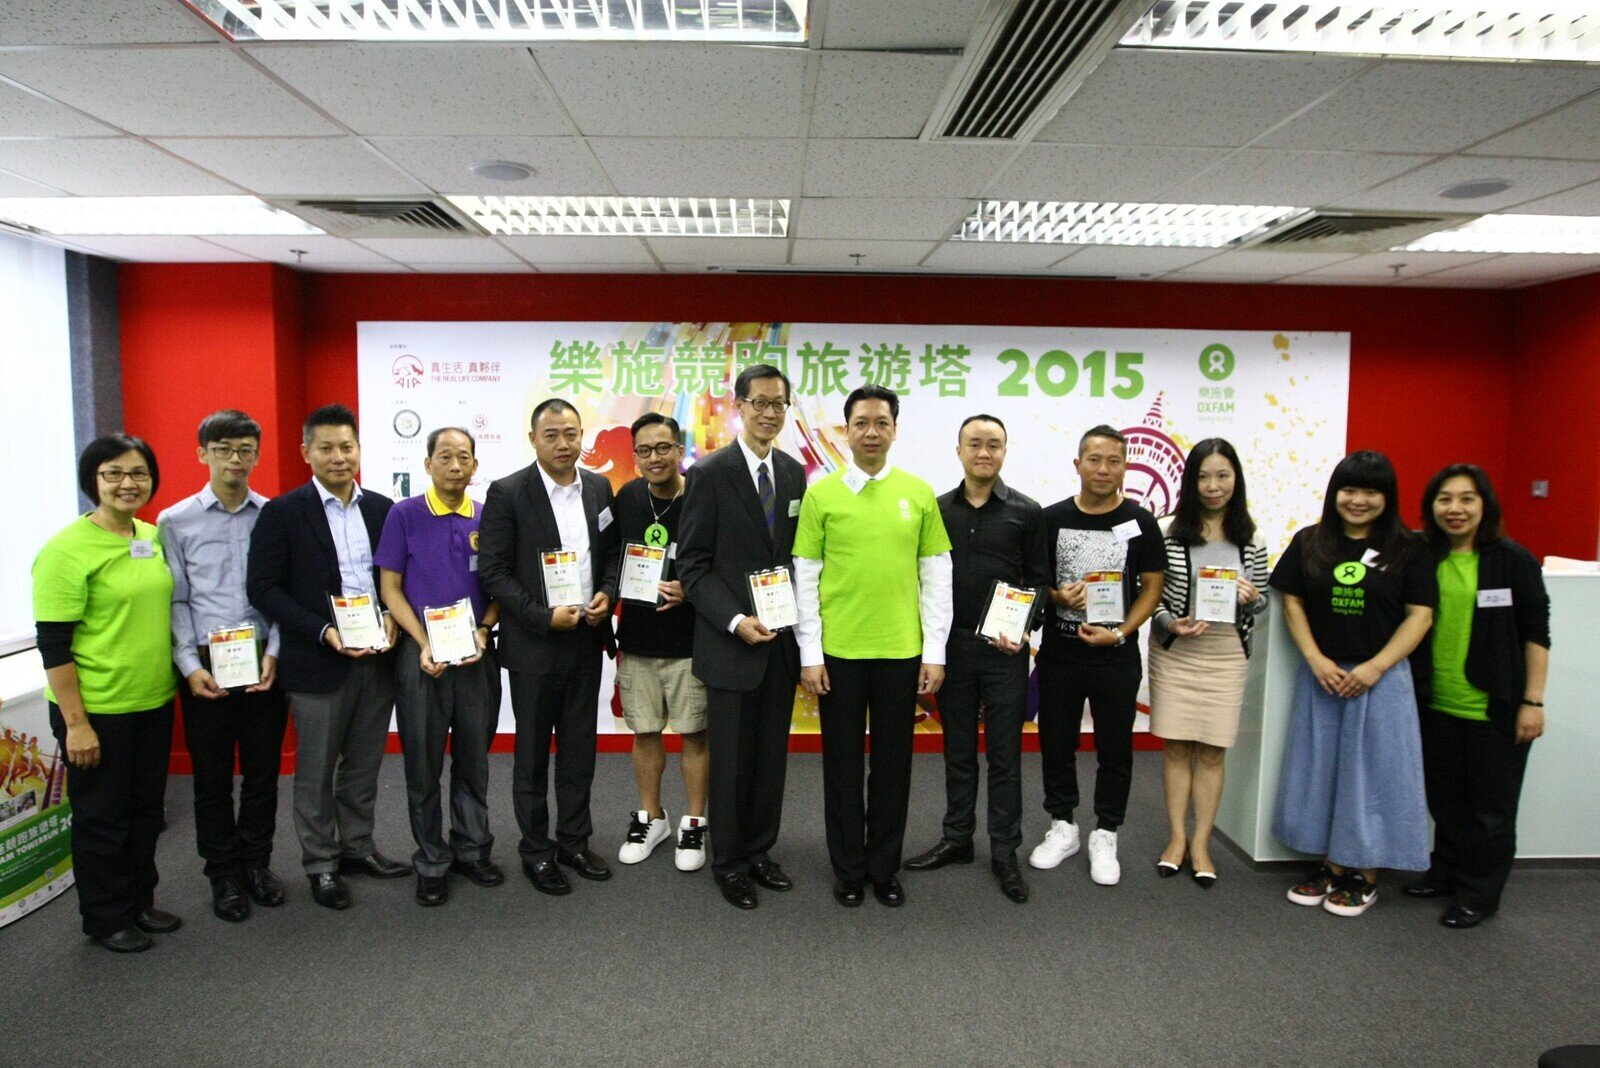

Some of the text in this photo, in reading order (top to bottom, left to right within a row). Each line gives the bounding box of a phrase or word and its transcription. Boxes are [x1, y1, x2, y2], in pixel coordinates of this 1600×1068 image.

[431, 361, 463, 374] 真生活
[431, 375, 501, 383] THE REAL LIFE COMPANY
[996, 348, 1145, 400] 2015
[395, 377, 422, 389] AIA
[1197, 402, 1235, 413] OXFAM
[1331, 597, 1365, 608] OXFAM
